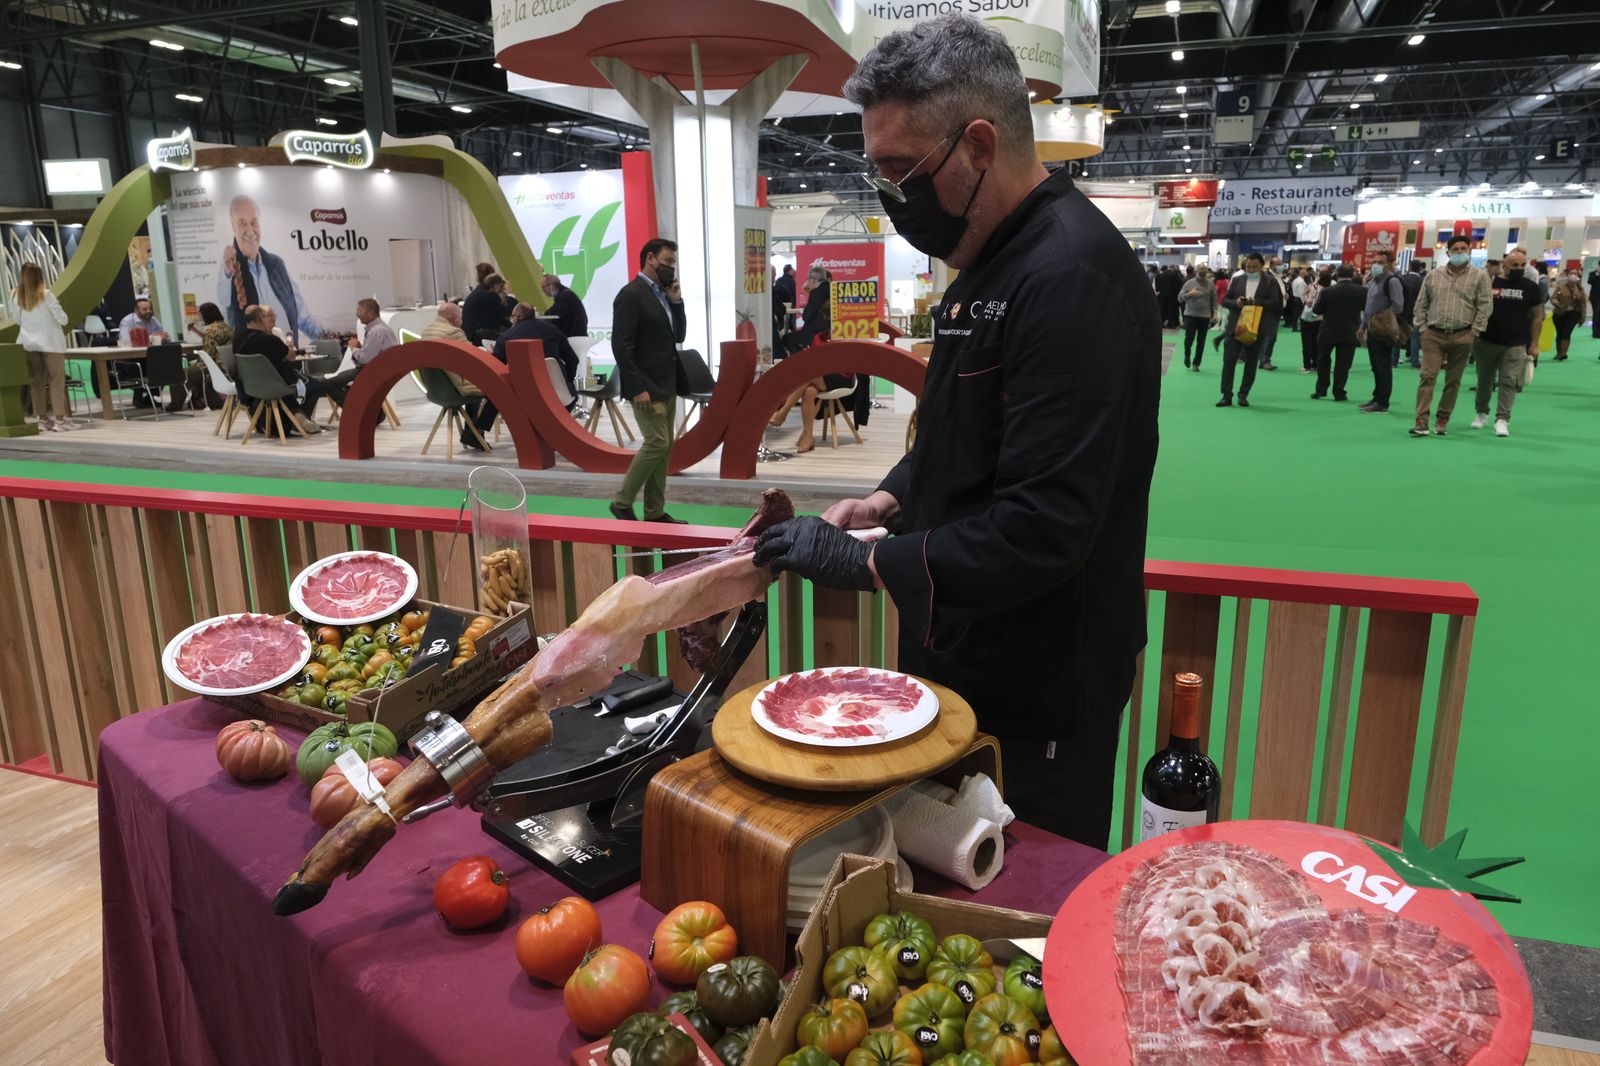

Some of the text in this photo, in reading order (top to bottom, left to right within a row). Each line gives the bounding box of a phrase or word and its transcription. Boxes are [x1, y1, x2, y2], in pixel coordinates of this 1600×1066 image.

[1238, 95, 1250, 113] 9
[293, 136, 363, 156] Caparrós
[1556, 140, 1569, 157] E
[1251, 185, 1351, 200] Restaurante
[314, 210, 344, 219] Caparrós
[1255, 201, 1334, 216] Restaurant
[1460, 203, 1512, 214] SAKATA
[290, 229, 369, 251] Lobello
[838, 282, 876, 297] SABOR
[831, 318, 880, 339] 2021
[1301, 851, 1417, 913] CASI
[902, 951, 919, 961] CASI
[1025, 973, 1042, 987] CASI
[957, 985, 974, 1003] CASI
[920, 1031, 938, 1042] CASI
